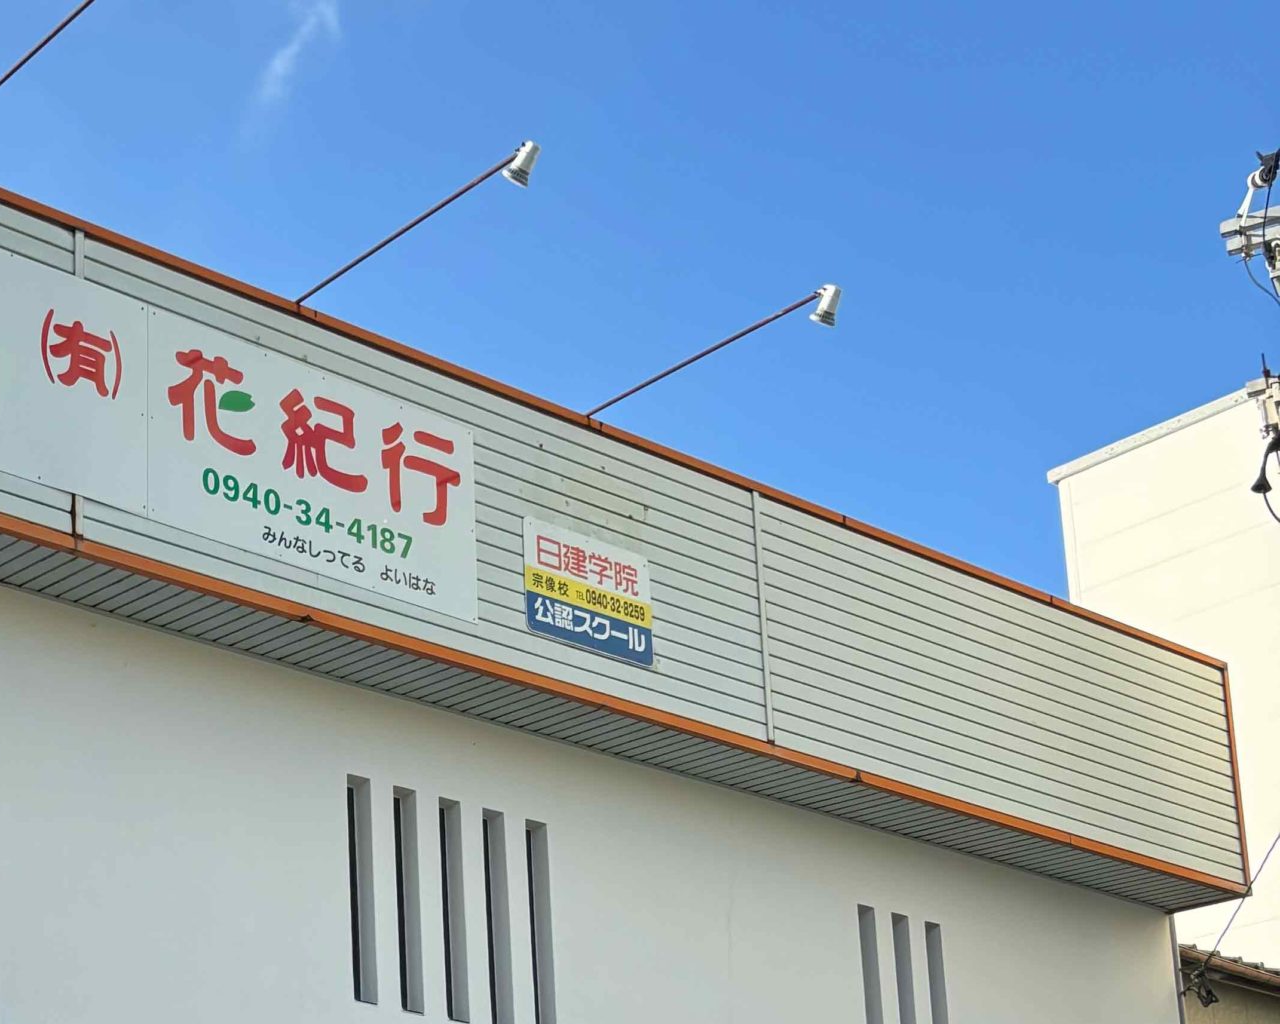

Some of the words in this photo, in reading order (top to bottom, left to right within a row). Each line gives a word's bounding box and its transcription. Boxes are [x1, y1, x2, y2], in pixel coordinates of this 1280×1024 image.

[167, 348, 462, 527] 花紀行
[201, 466, 414, 560] 0940-34-4187
[261, 524, 366, 575] みんなしってる
[379, 563, 437, 596] よいはな
[531, 572, 570, 598] 宗像校
[536, 534, 639, 597] 日建学院
[534, 596, 646, 653] 公認スクール
[585, 588, 646, 623] 0940-32-8259
